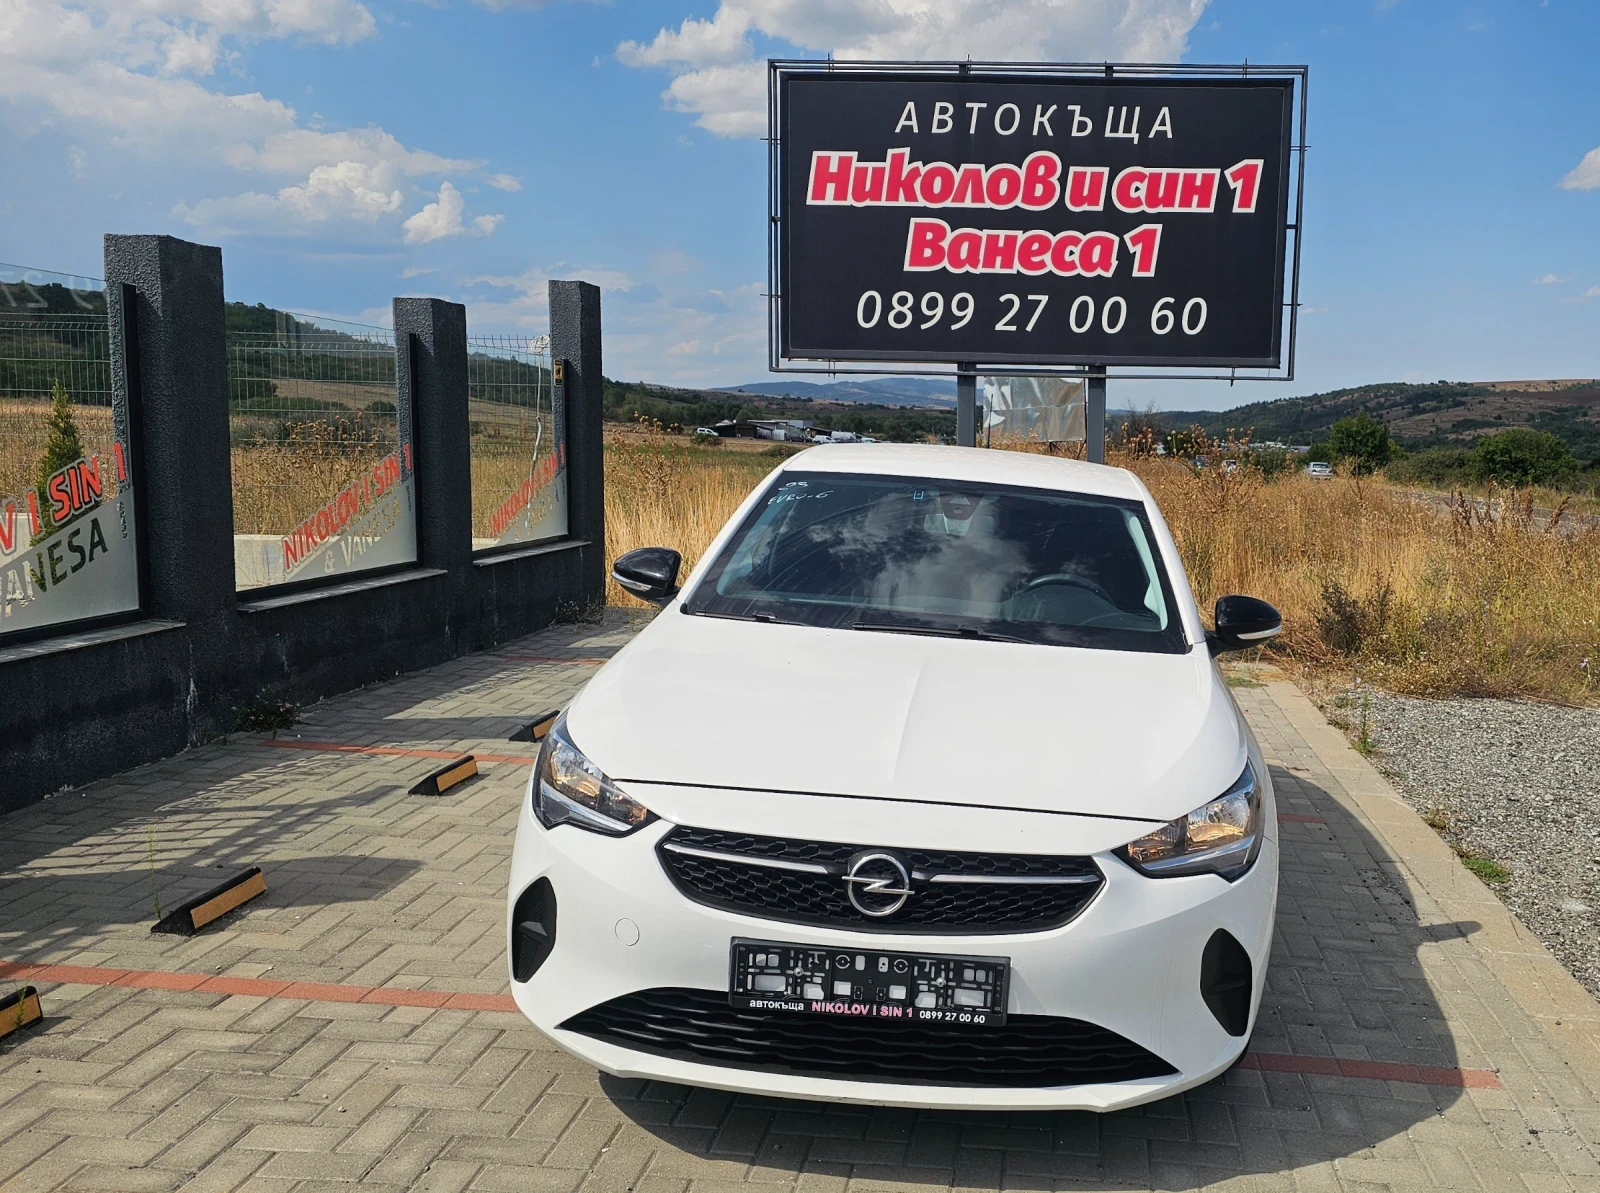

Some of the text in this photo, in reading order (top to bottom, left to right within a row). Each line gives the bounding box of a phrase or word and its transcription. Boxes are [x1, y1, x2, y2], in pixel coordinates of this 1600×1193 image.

[895, 102, 1173, 145] АВТОКЪЩА
[806, 147, 1264, 213] Николов и син 1
[903, 218, 1162, 277] Ванеса 1
[857, 290, 1208, 336] 0899 27 00 60
[48, 455, 103, 522] SIN
[283, 482, 359, 570] NIKOLOV
[374, 452, 400, 496] SIN
[0, 517, 109, 618] ANESA
[749, 999, 804, 1012] автокъща
[811, 1001, 870, 1015] NIKOLOV
[879, 1005, 902, 1017] SIN
[906, 1007, 913, 1018] 1
[919, 1010, 986, 1024] 0899 27 00 60
